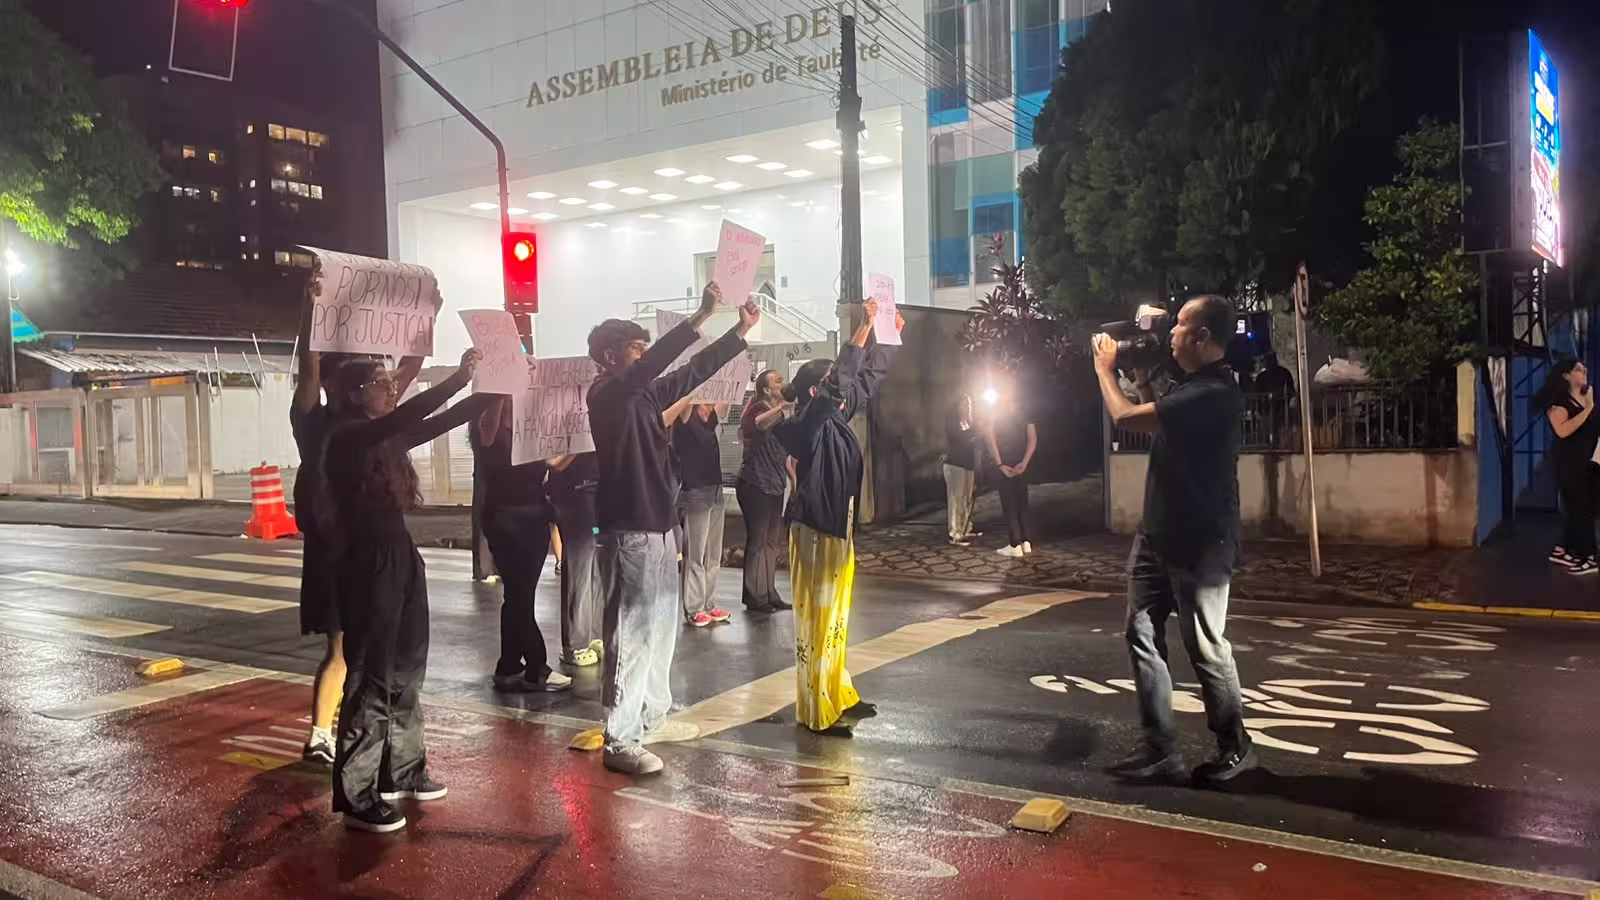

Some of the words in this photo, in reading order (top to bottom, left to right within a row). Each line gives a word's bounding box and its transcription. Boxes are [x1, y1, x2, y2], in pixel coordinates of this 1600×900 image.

[526, 37, 721, 108] ASSEMBLEIA
[730, 21, 775, 57] DE
[660, 71, 755, 107] Ministério
[762, 62, 789, 84] de
[794, 35, 881, 76] Taubté
[312, 304, 351, 342] POR
